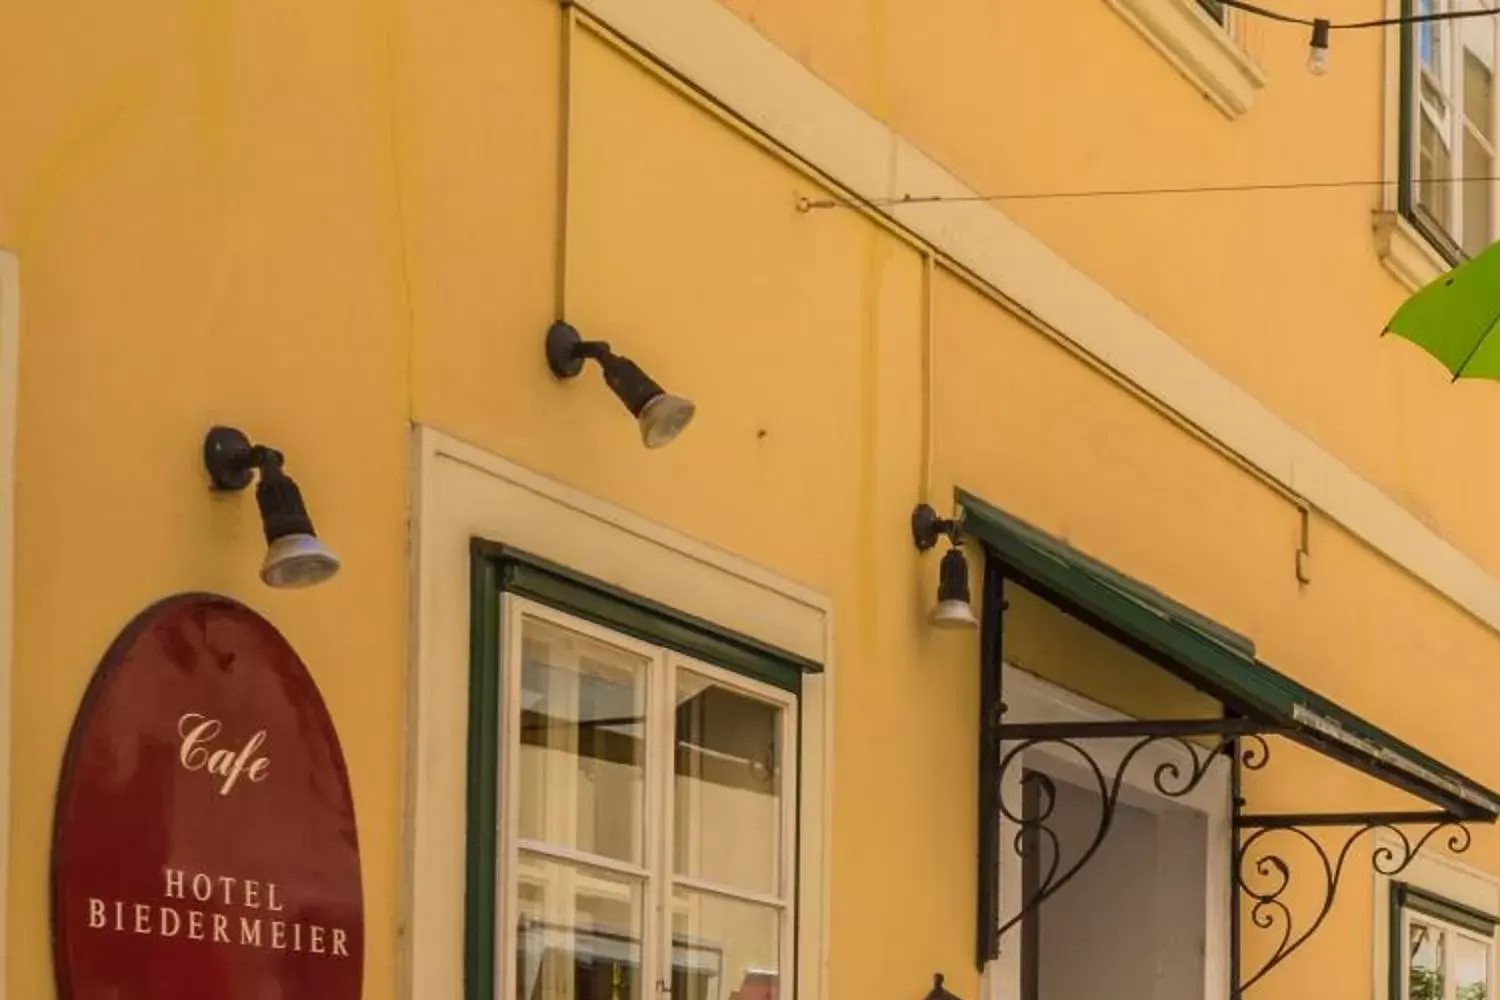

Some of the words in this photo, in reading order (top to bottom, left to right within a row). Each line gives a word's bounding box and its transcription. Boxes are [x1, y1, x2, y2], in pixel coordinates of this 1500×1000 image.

[178, 713, 271, 796] Cafe
[165, 868, 283, 912] HOTEL
[88, 897, 350, 957] BIEDERMEIER
